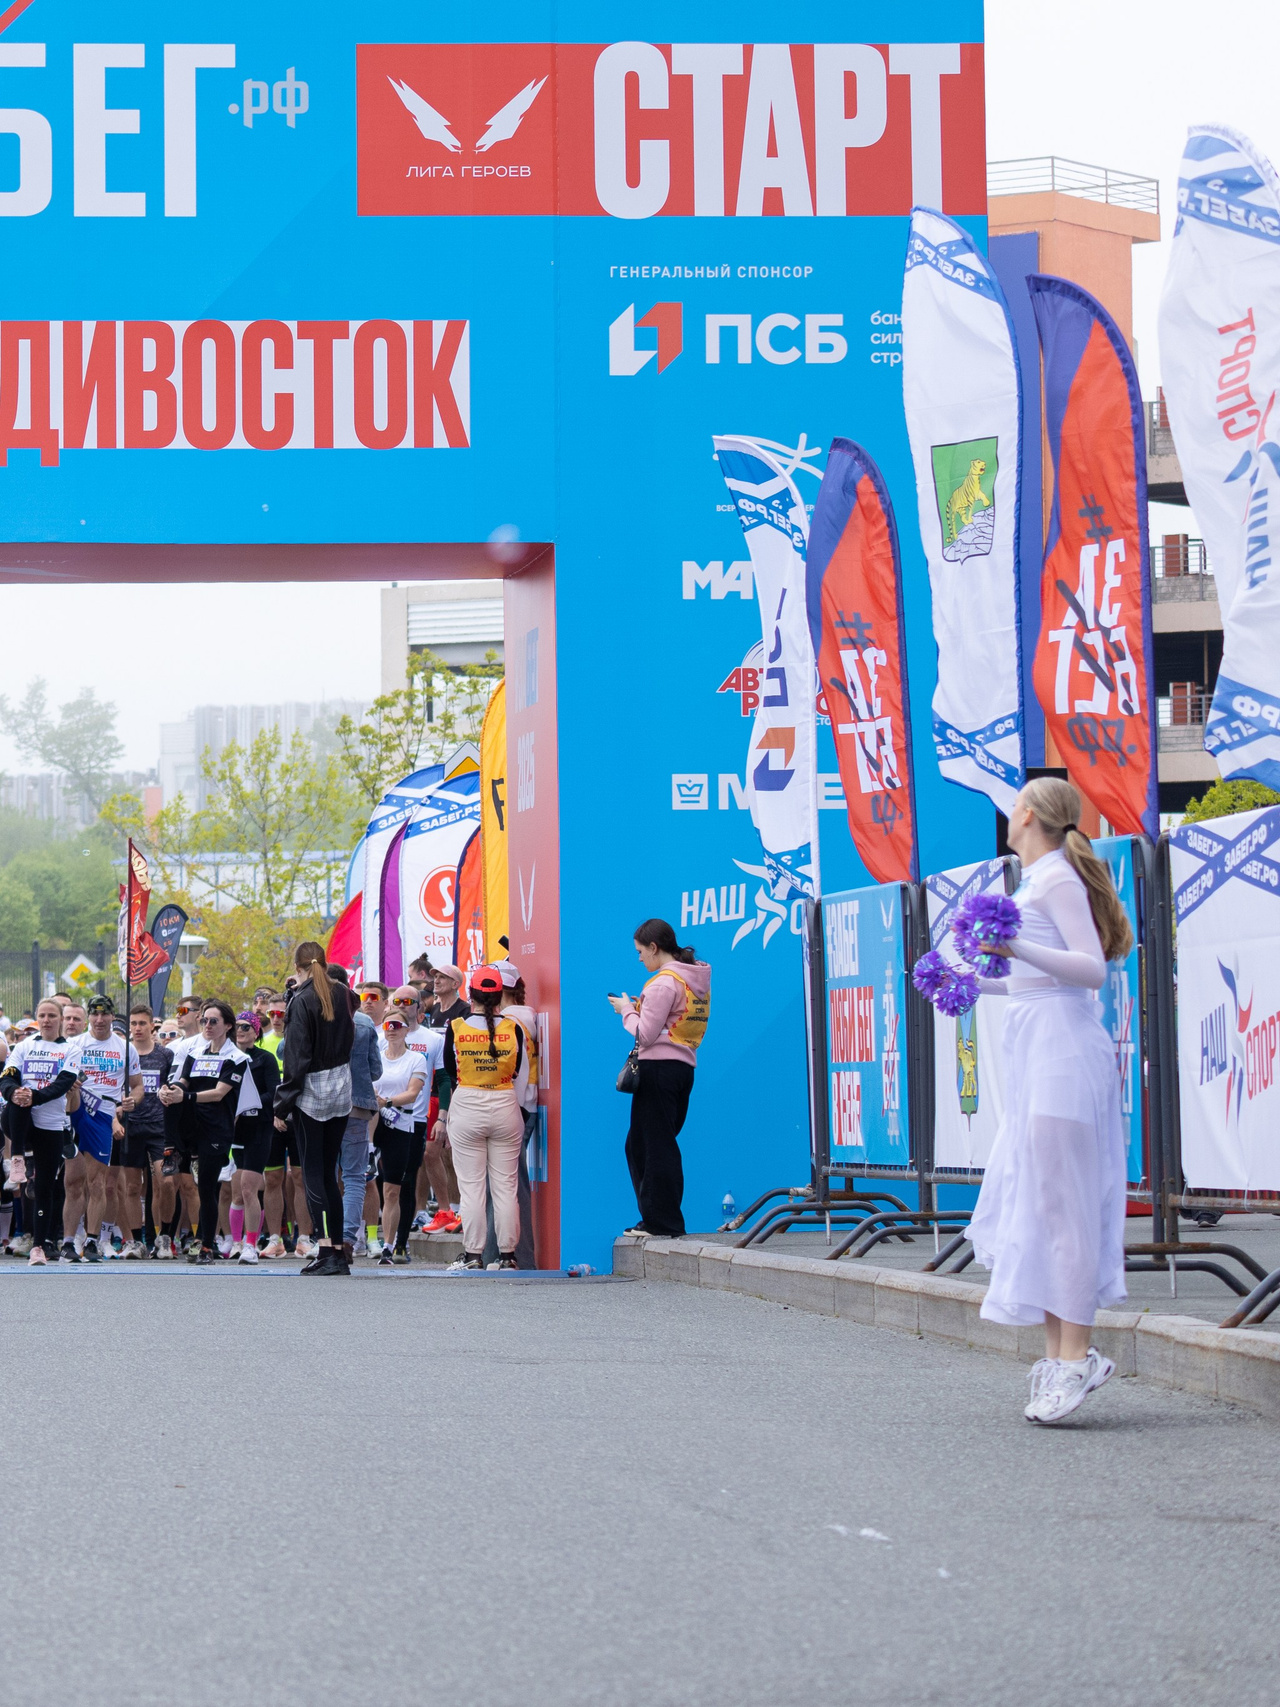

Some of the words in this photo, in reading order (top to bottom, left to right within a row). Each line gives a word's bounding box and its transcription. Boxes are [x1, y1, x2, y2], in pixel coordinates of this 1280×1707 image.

[593, 41, 961, 219] СТАРТ
[406, 165, 454, 178] ЛИГА
[461, 165, 531, 178] ГЕРОЕВ
[610, 264, 731, 279] ГЕНЕРАЛЬНЫЙ
[737, 265, 814, 279] СПОНСОР
[870, 310, 903, 326] бан
[705, 312, 849, 366] ПСБ
[870, 333, 903, 345] сил
[870, 352, 903, 367] стр
[716, 504, 736, 513] ВСЕР
[682, 561, 754, 600] МА
[1223, 823, 1268, 874] ЗАБЕГ.РФ
[1177, 868, 1214, 915] ЗАБЕГ.РФ
[680, 882, 747, 928] НАШ
[424, 932, 454, 947] slav
[1199, 1002, 1228, 1087] НАШ
[1245, 1009, 1280, 1101] СПОРТ
[27, 1063, 54, 1073] 30557
[142, 1076, 157, 1087] 023
[381, 1107, 397, 1121] 092
